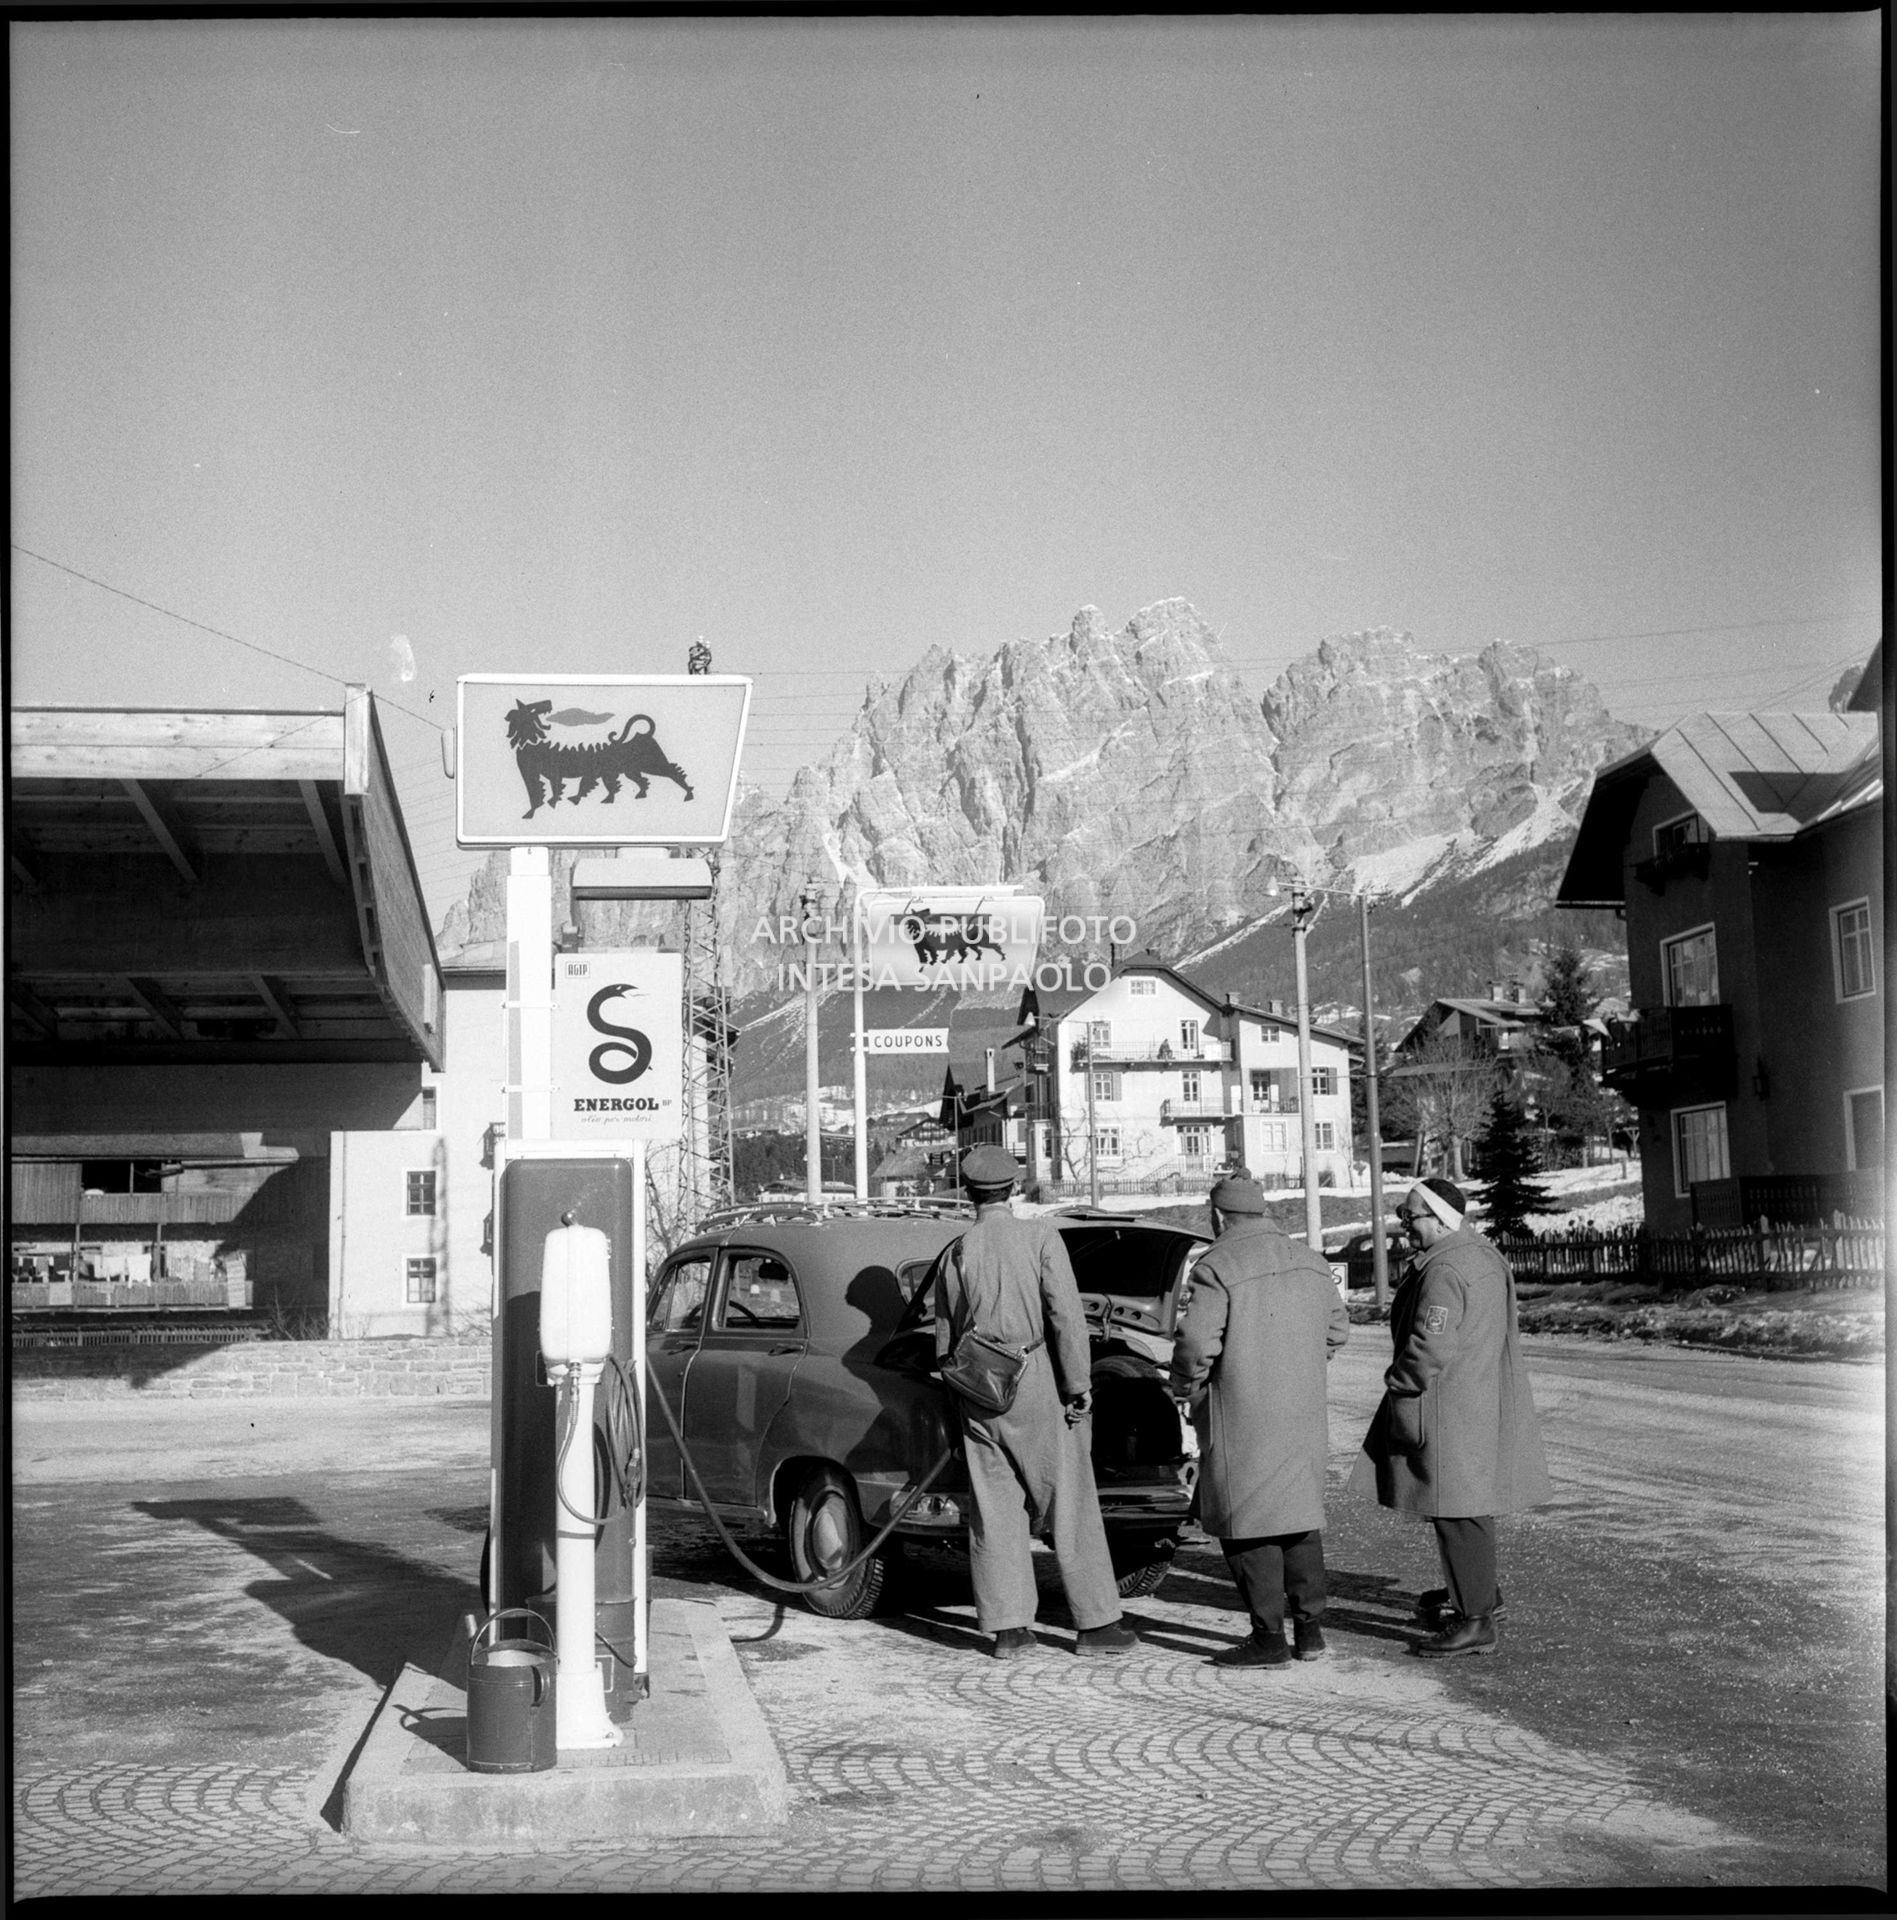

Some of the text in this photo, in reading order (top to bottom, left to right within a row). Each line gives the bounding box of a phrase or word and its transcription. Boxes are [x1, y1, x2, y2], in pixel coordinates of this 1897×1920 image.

[568, 964, 587, 976] AGIP
[874, 1035, 943, 1048] COUPONS
[574, 1098, 659, 1112] ENERGOL
